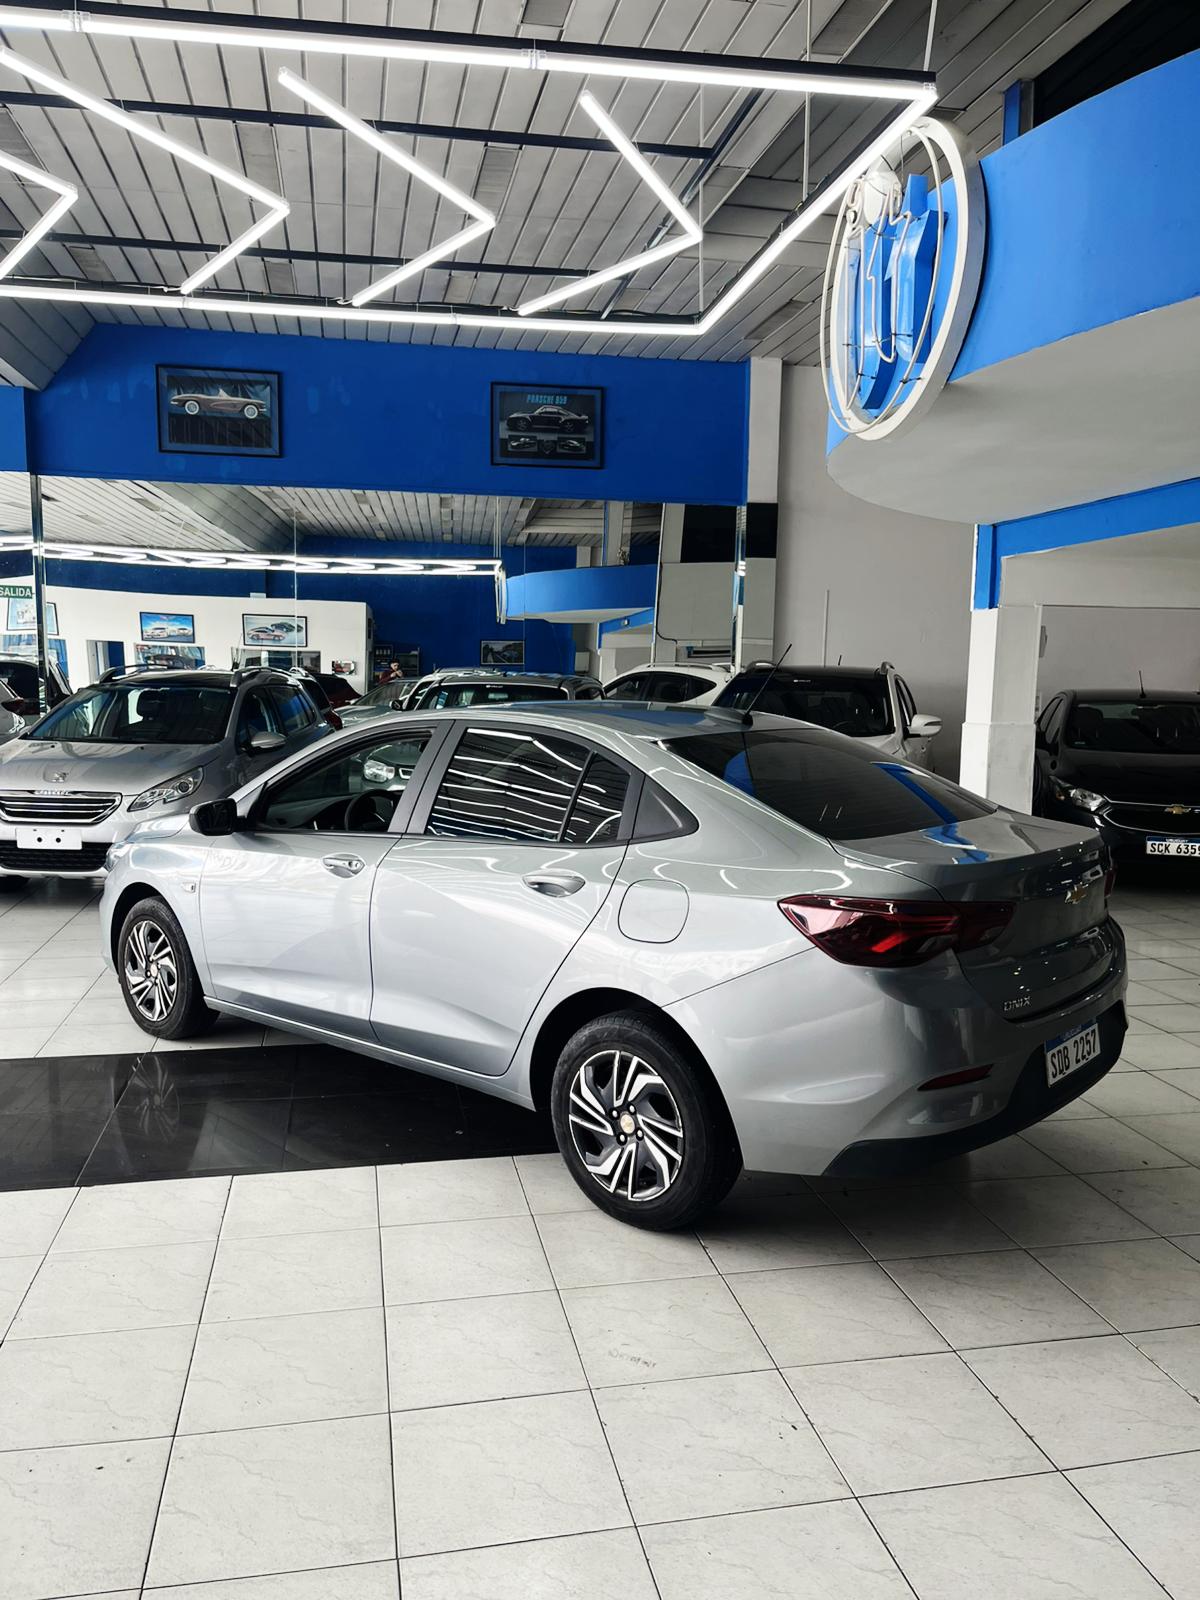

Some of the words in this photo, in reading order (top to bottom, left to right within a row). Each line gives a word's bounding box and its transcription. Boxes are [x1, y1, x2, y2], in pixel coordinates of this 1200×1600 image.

[0, 587, 32, 597] SALIDA
[1150, 843, 1171, 854] SCK
[1004, 996, 1030, 1011] ONIX
[1050, 1046, 1070, 1078] SDB
[1073, 1029, 1095, 1064] 2257
